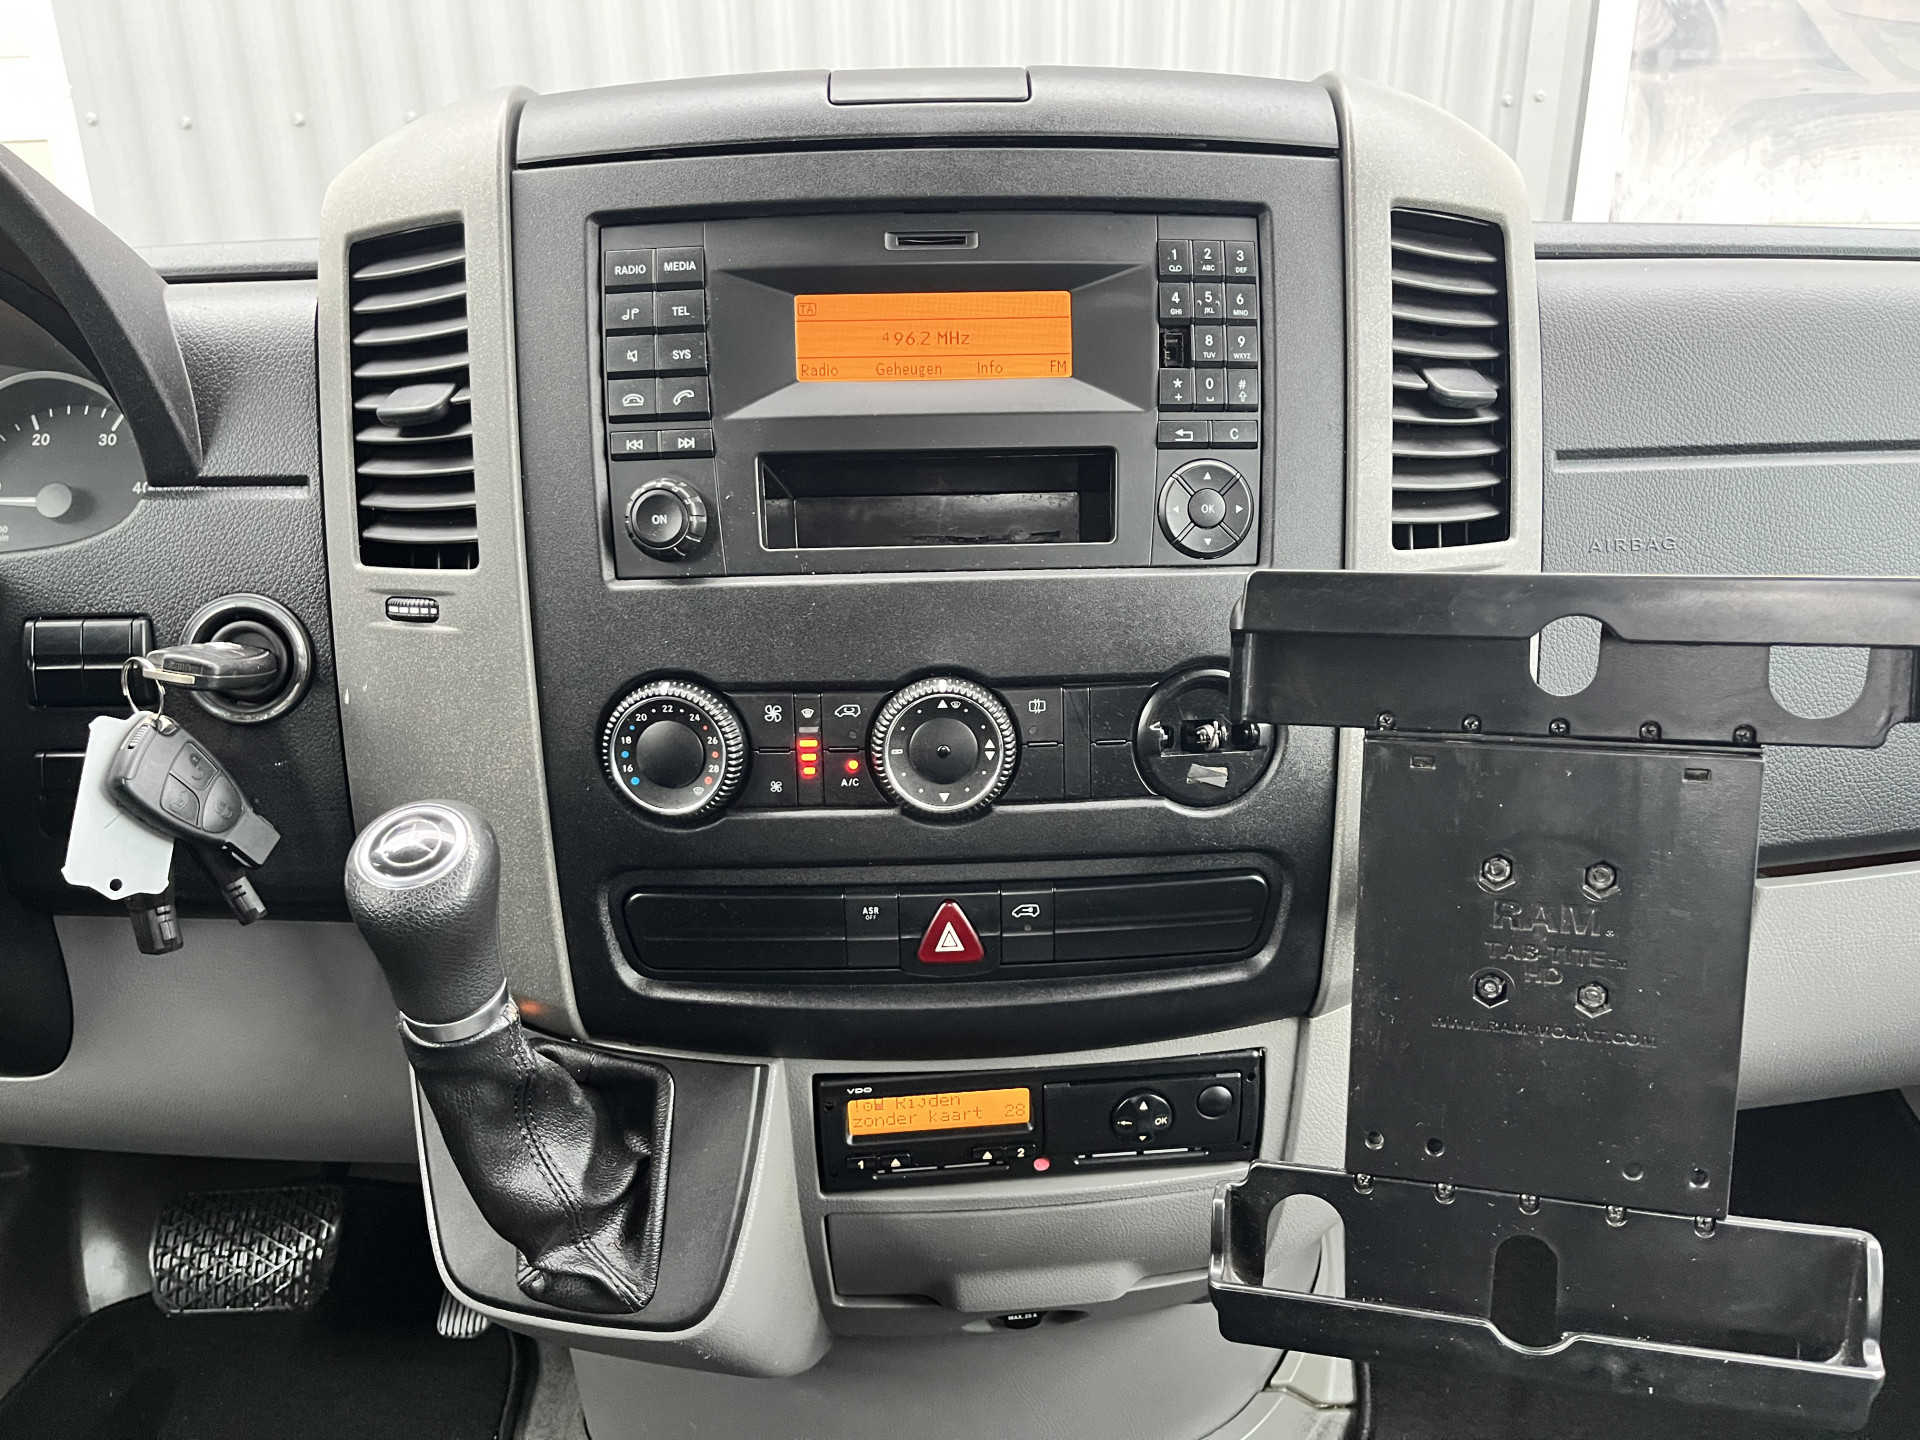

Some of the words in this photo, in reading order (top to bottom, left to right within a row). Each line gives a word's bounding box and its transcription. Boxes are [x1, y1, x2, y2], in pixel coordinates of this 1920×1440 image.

[1172, 249, 1177, 260] 1
[1204, 248, 1211, 259] 2
[1237, 250, 1244, 261] 3
[615, 264, 646, 275] RADIO
[664, 261, 696, 272] MEDIA
[1172, 292, 1180, 304] 4
[1205, 291, 1212, 302] 5
[1236, 294, 1244, 305] 6
[672, 306, 690, 316] TEL
[801, 305, 813, 314] TA
[938, 331, 970, 345] MHz
[1205, 335, 1213, 346] 8
[1238, 336, 1245, 347] 9
[672, 350, 691, 360] SYS
[801, 363, 838, 377] Radio
[876, 362, 942, 378] Geheugen
[977, 361, 1003, 374] Info
[1050, 360, 1067, 373] FM
[1230, 428, 1239, 440] C
[32, 434, 50, 446] 20
[98, 434, 117, 446] 30
[1201, 504, 1215, 513] OK
[652, 515, 667, 524] ON
[1588, 537, 1676, 553] AIRBAG
[662, 705, 673, 713] 22
[635, 714, 647, 722] 20
[689, 713, 700, 722] 24
[621, 736, 631, 744] 18
[707, 736, 718, 745] 26
[622, 764, 633, 773] 16
[709, 764, 720, 773] 28
[841, 778, 859, 786] A/C
[862, 907, 879, 915] ASR
[853, 1112, 917, 1128] zonder
[929, 1108, 982, 1123] kaart
[1004, 1104, 1025, 1117] 28
[1155, 1116, 1168, 1126] OK
[1017, 1148, 1025, 1157] 2
[858, 1160, 864, 1169] 1
